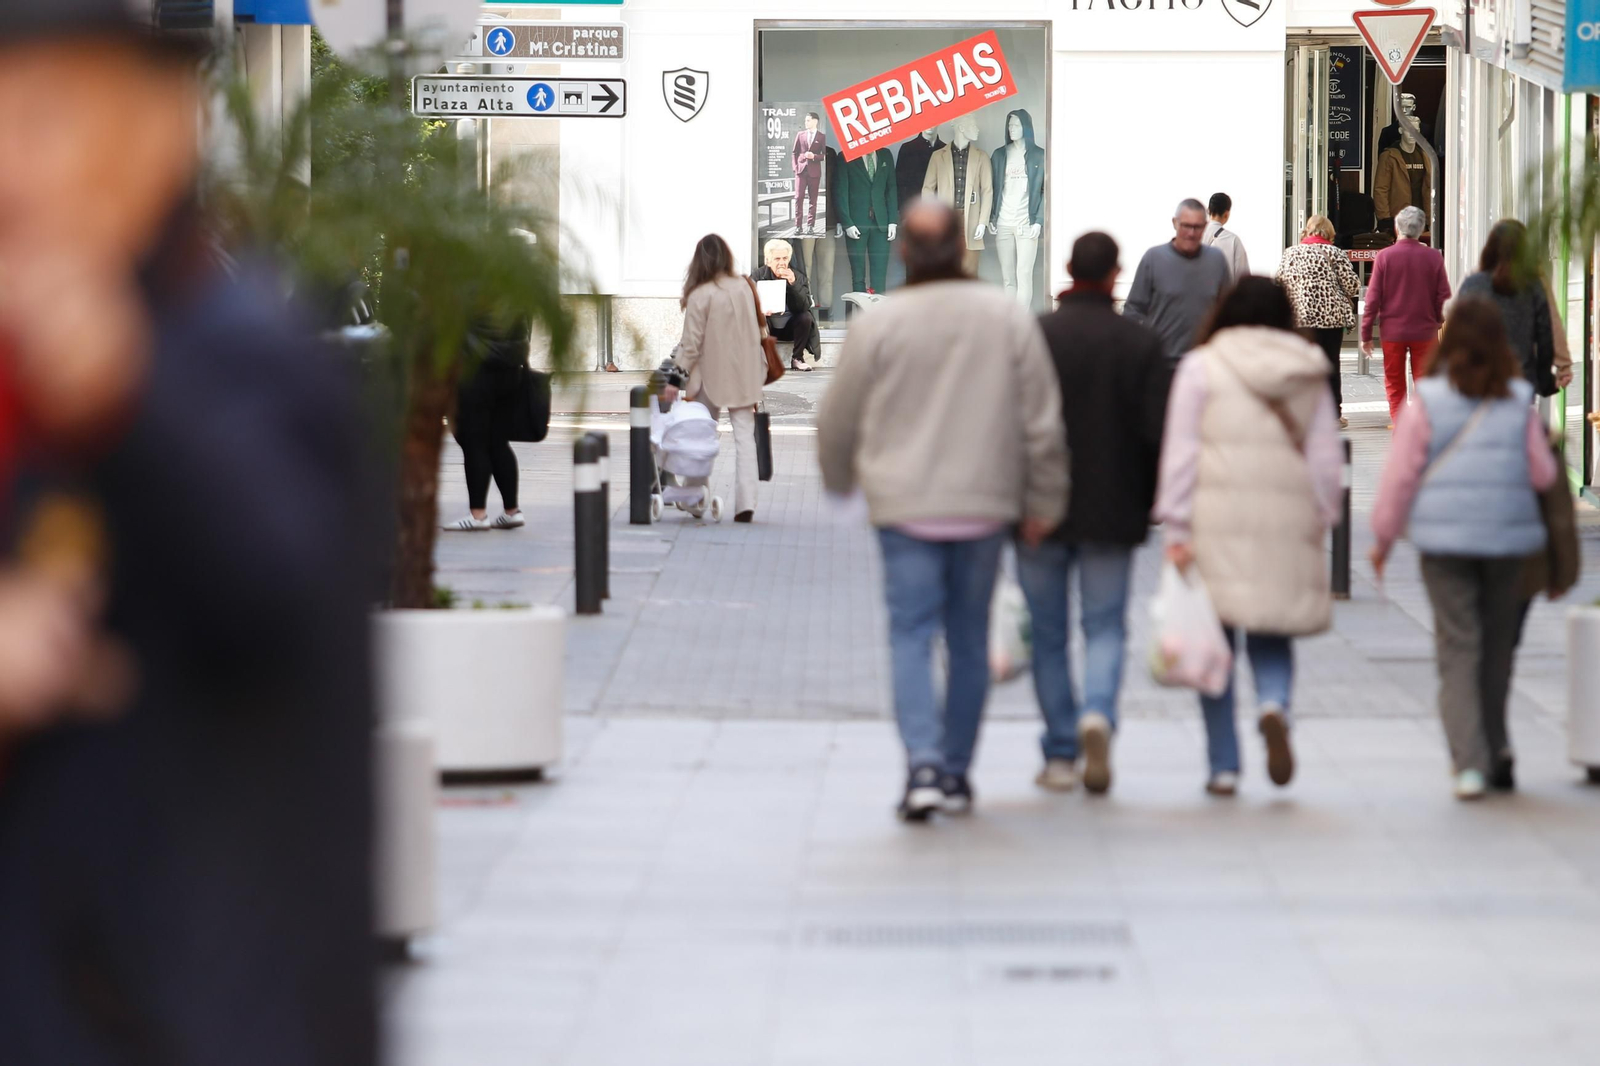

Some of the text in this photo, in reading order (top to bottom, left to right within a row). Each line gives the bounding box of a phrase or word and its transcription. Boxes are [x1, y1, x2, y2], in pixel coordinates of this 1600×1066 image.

[573, 29, 618, 40] parque
[552, 41, 618, 56] Cristina
[423, 83, 515, 94] ayuntamiento
[832, 42, 1003, 142] REBAJAS
[423, 97, 514, 111] Plaza Alta
[762, 108, 797, 117] TRAJE
[847, 126, 893, 150] EN EL SPORT
